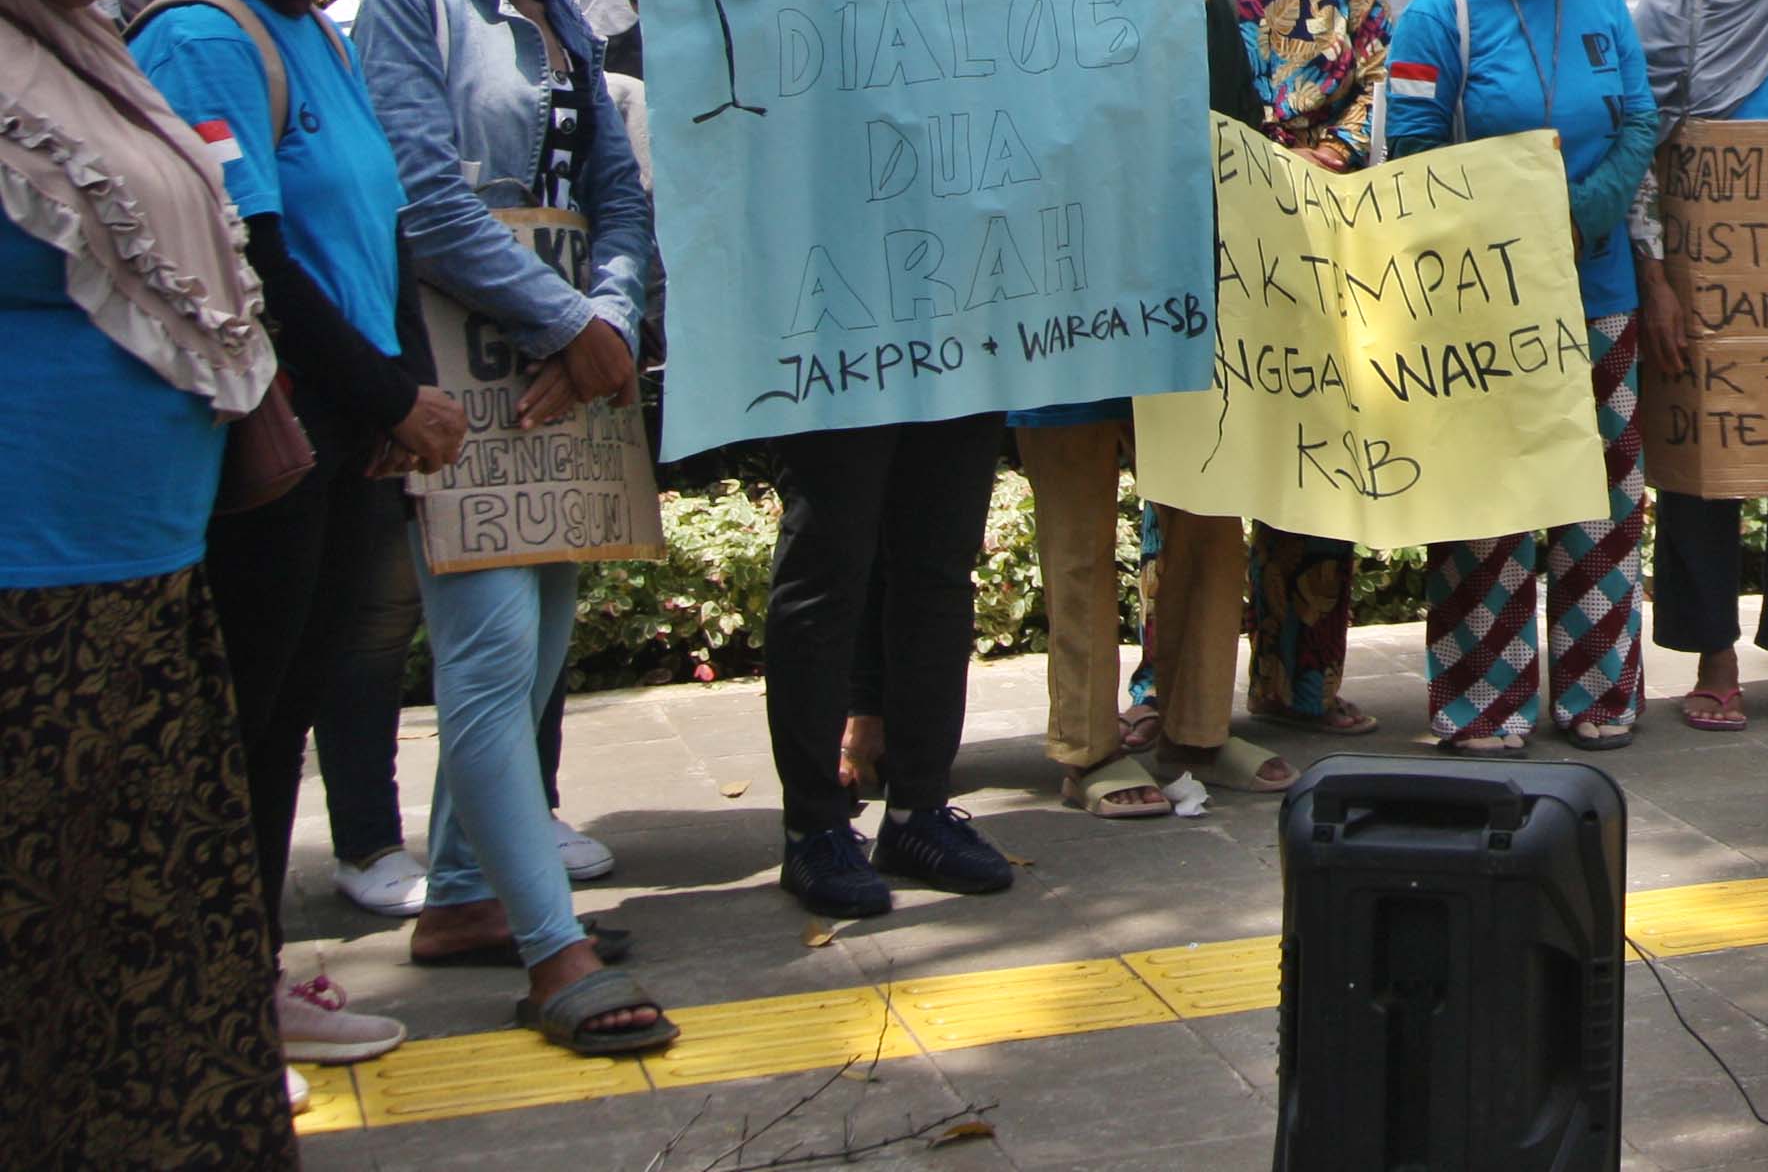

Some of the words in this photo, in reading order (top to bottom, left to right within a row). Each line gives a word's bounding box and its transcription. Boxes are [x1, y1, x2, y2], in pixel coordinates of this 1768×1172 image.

[866, 110, 1041, 202] DUA
[1216, 121, 1474, 230] ENJAMIN
[781, 202, 1089, 339] ARAH
[1217, 237, 1298, 308] AK
[745, 337, 964, 413] JAKPRO
[1017, 308, 1128, 364] WARGA
[1140, 292, 1209, 340] KSB
[1371, 317, 1591, 404] WARGA
[1660, 355, 1744, 395] AK
[1298, 422, 1421, 500] KSB
